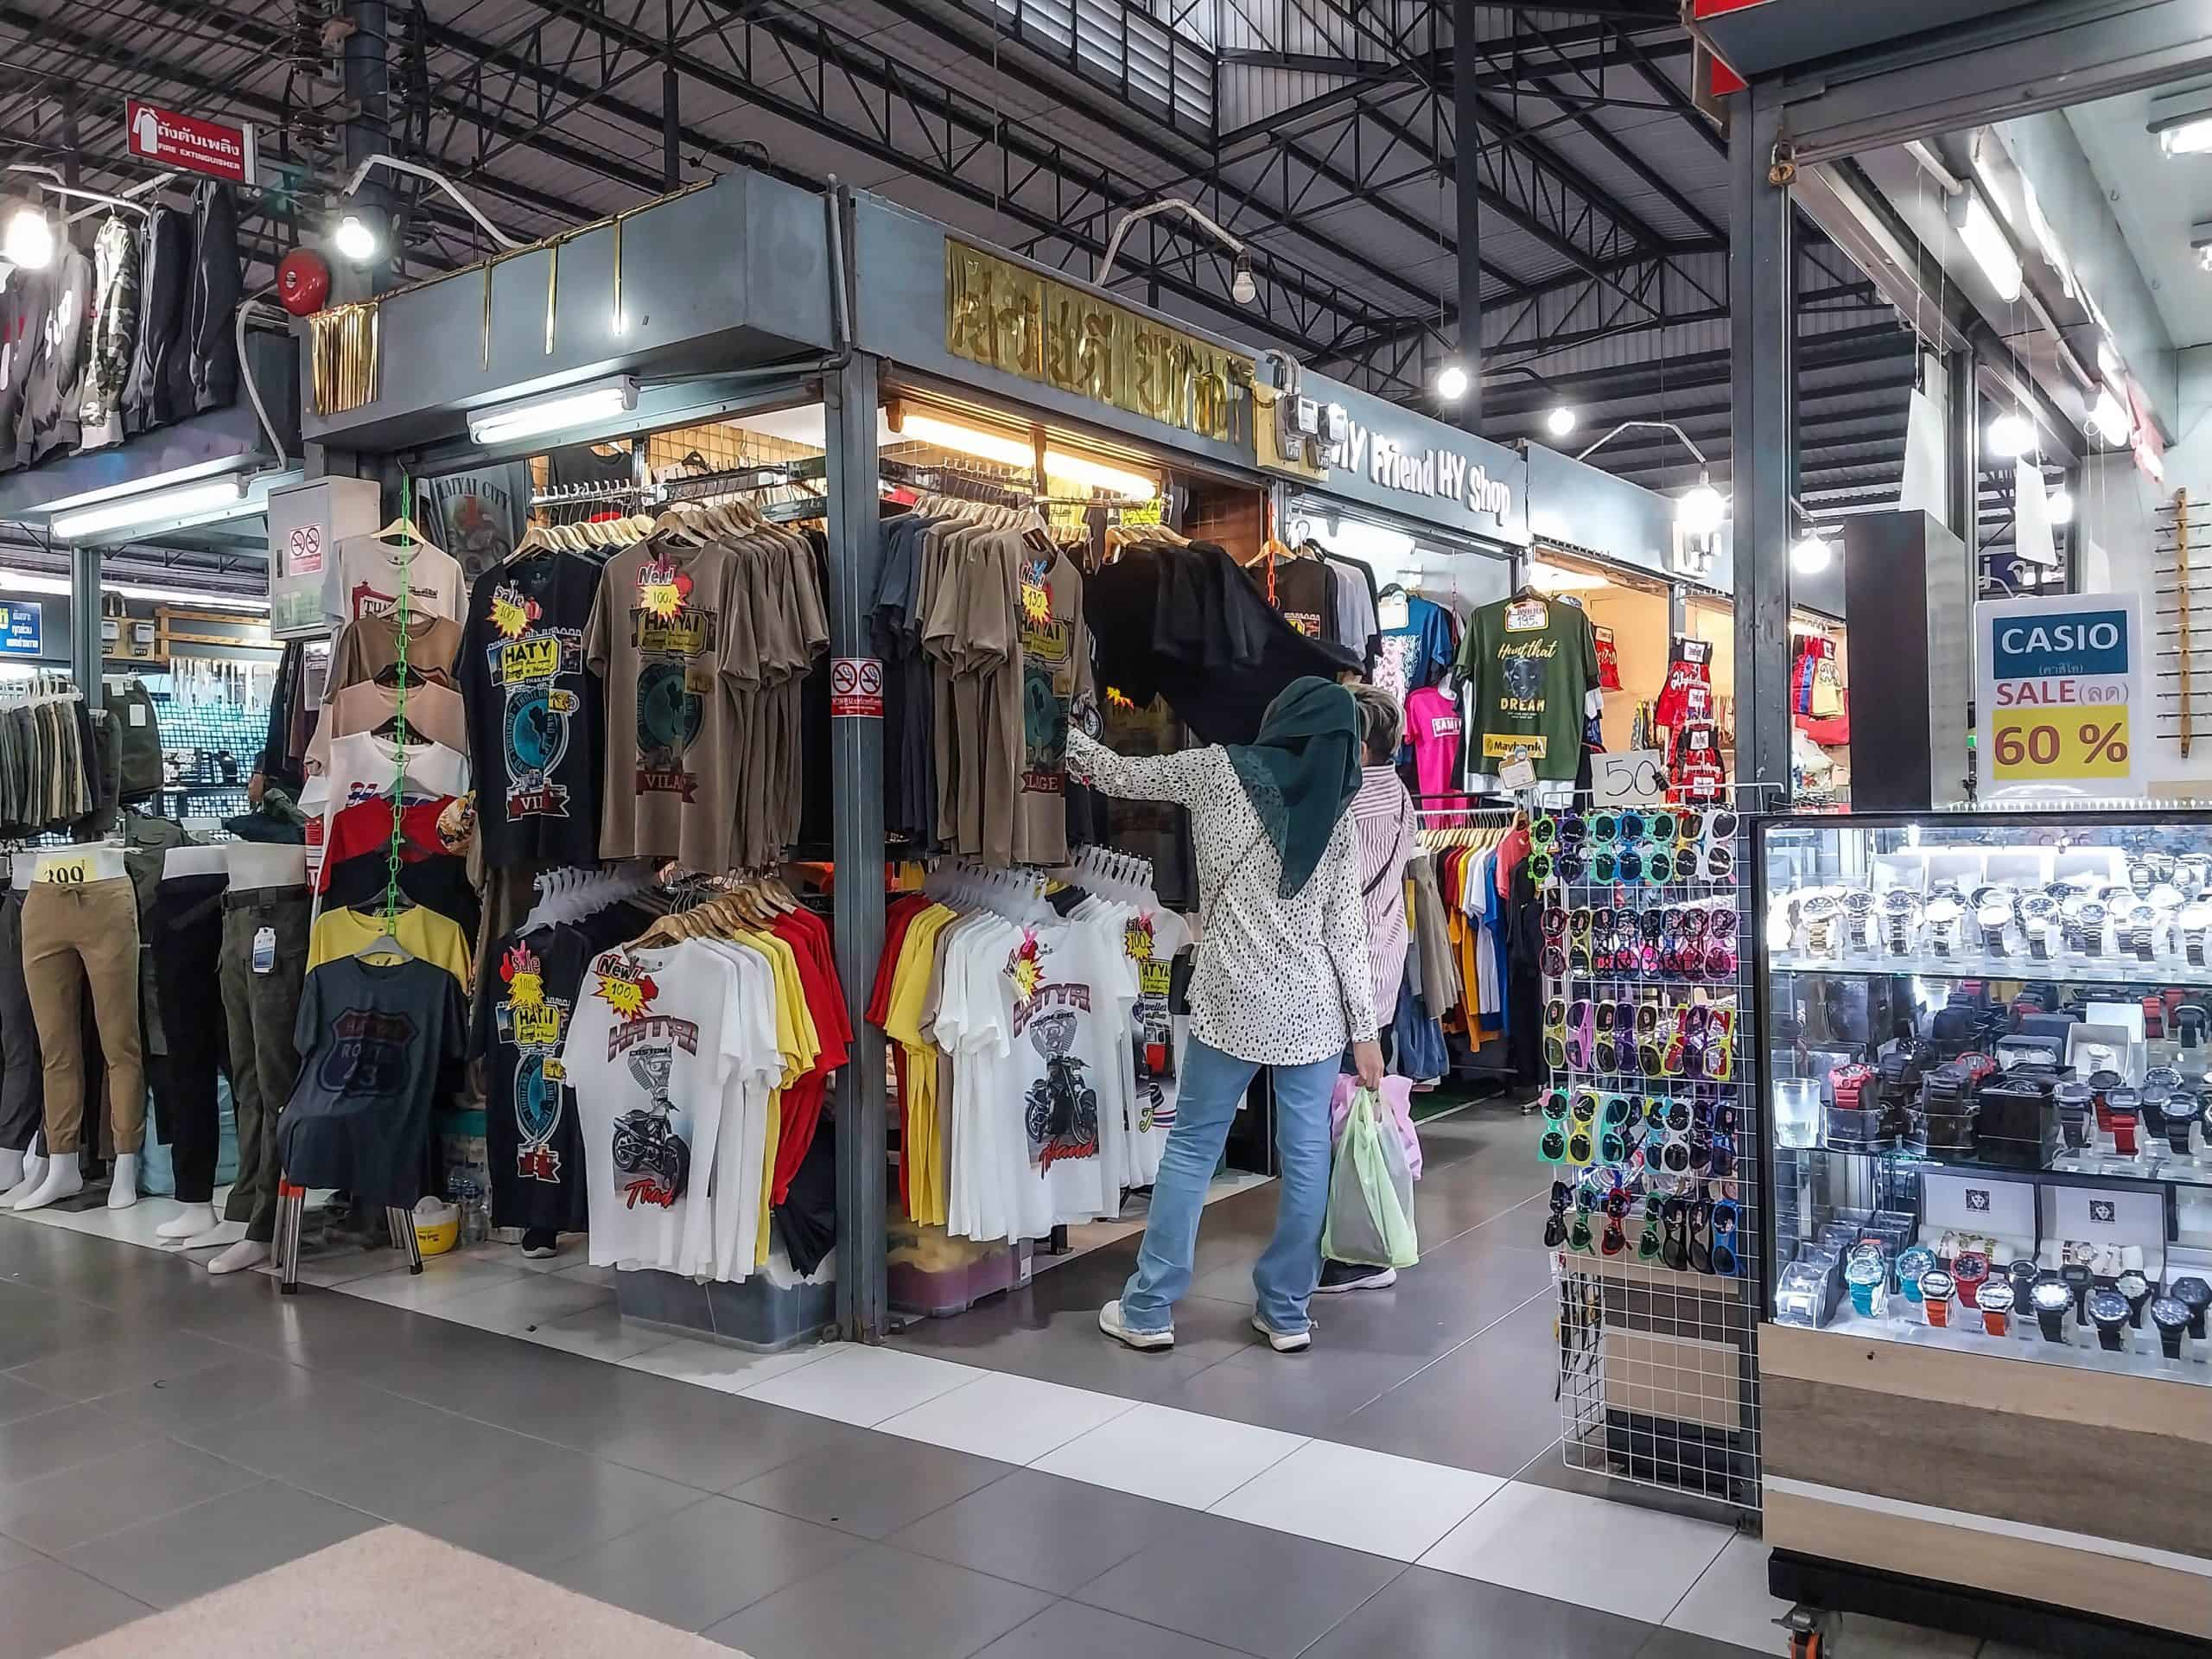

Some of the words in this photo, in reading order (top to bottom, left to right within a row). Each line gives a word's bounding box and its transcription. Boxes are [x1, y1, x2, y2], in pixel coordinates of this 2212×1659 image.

[157, 142, 176, 154] FIRE
[179, 148, 240, 169] EXTINGUISHER
[1370, 431, 1434, 498] Friend
[1438, 448, 1466, 500] HY
[482, 481, 508, 512] CITY
[1497, 641, 1527, 660] Hunt
[1526, 638, 1558, 658] that
[2001, 622, 2120, 655] CASIO
[1499, 697, 1546, 713] DREAM
[1996, 679, 2076, 706] SALE
[1994, 724, 2061, 766] 60
[2079, 721, 2128, 765] %
[1605, 760, 1660, 797] 50
[598, 955, 641, 983] New!
